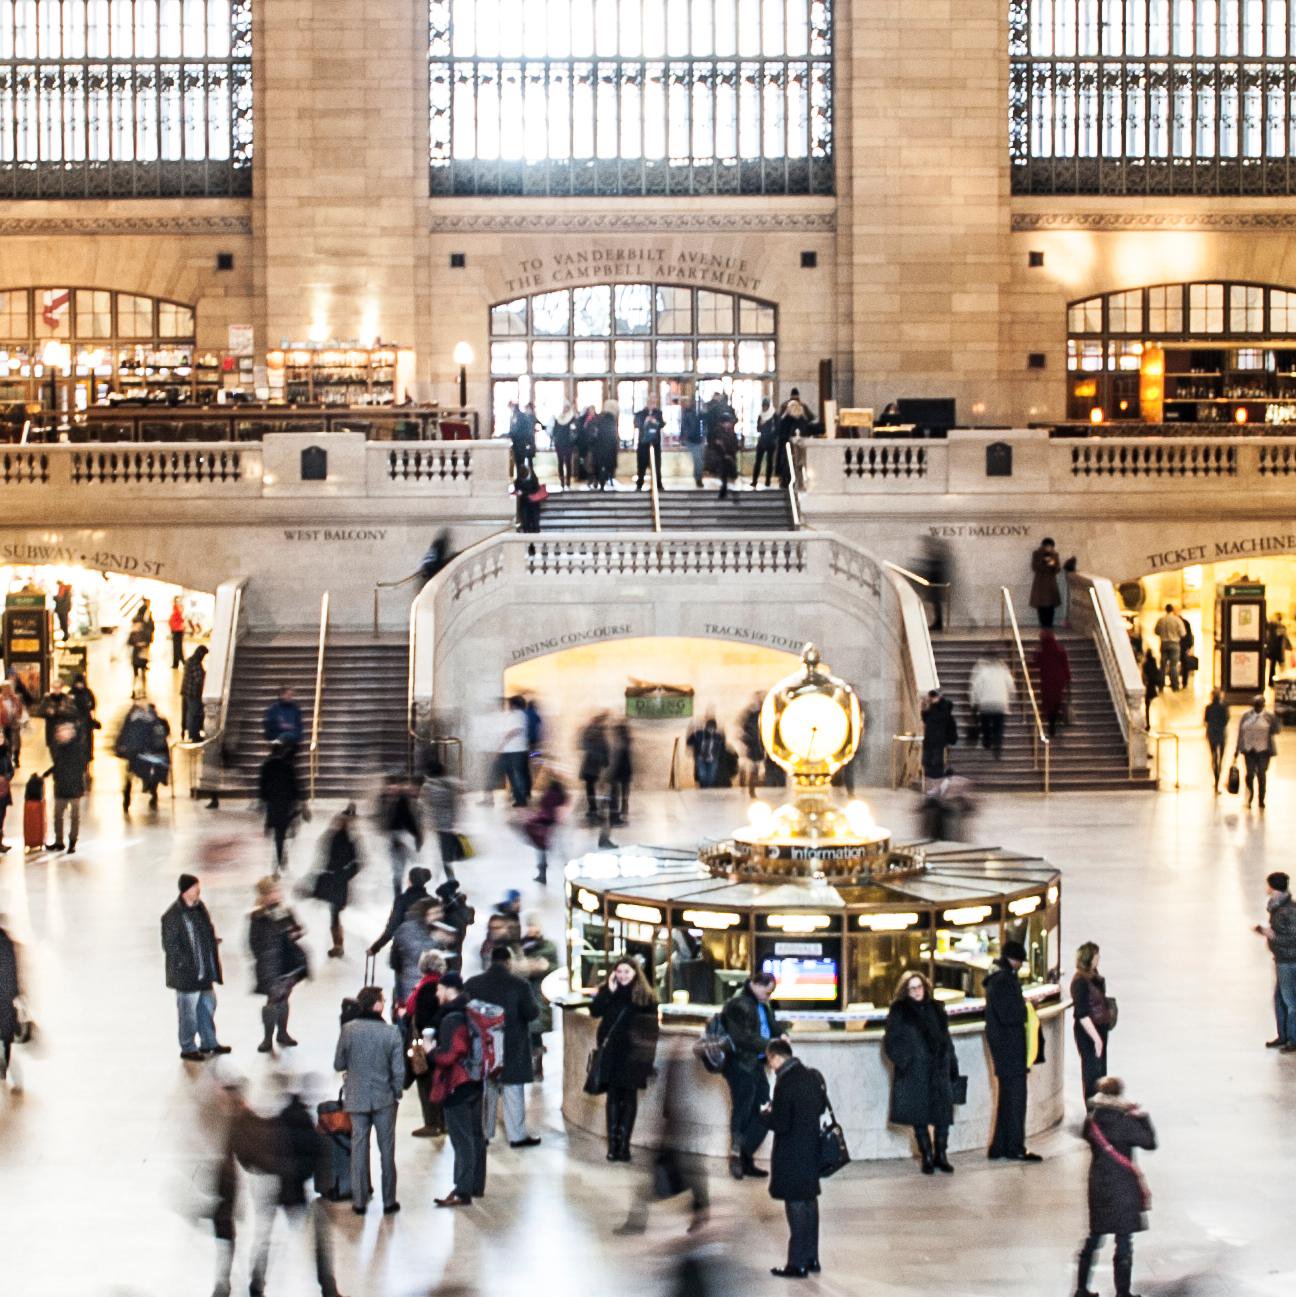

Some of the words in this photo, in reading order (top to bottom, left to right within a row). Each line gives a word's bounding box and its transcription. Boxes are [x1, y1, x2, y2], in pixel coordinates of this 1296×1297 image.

[519, 258, 543, 272] TO
[553, 248, 665, 265] VANDERBILT
[678, 250, 748, 271] AVENUE
[505, 274, 544, 291] THE
[552, 264, 643, 280] CAMPBELL
[656, 264, 761, 290] APARTMENT
[284, 529, 320, 540] WEST
[324, 529, 387, 540] BALCONY
[929, 525, 964, 537] WEST
[968, 525, 1031, 537] BALCONY
[4, 543, 76, 561] SUBWAY
[90, 552, 138, 571] 42ND
[142, 561, 165, 575] ST
[1147, 545, 1206, 568] TICKET
[511, 637, 559, 659] DINING
[561, 624, 632, 643] CONCOURSE
[704, 624, 750, 638] TRACKS
[770, 635, 787, 646] TO
[791, 845, 865, 860] Information
